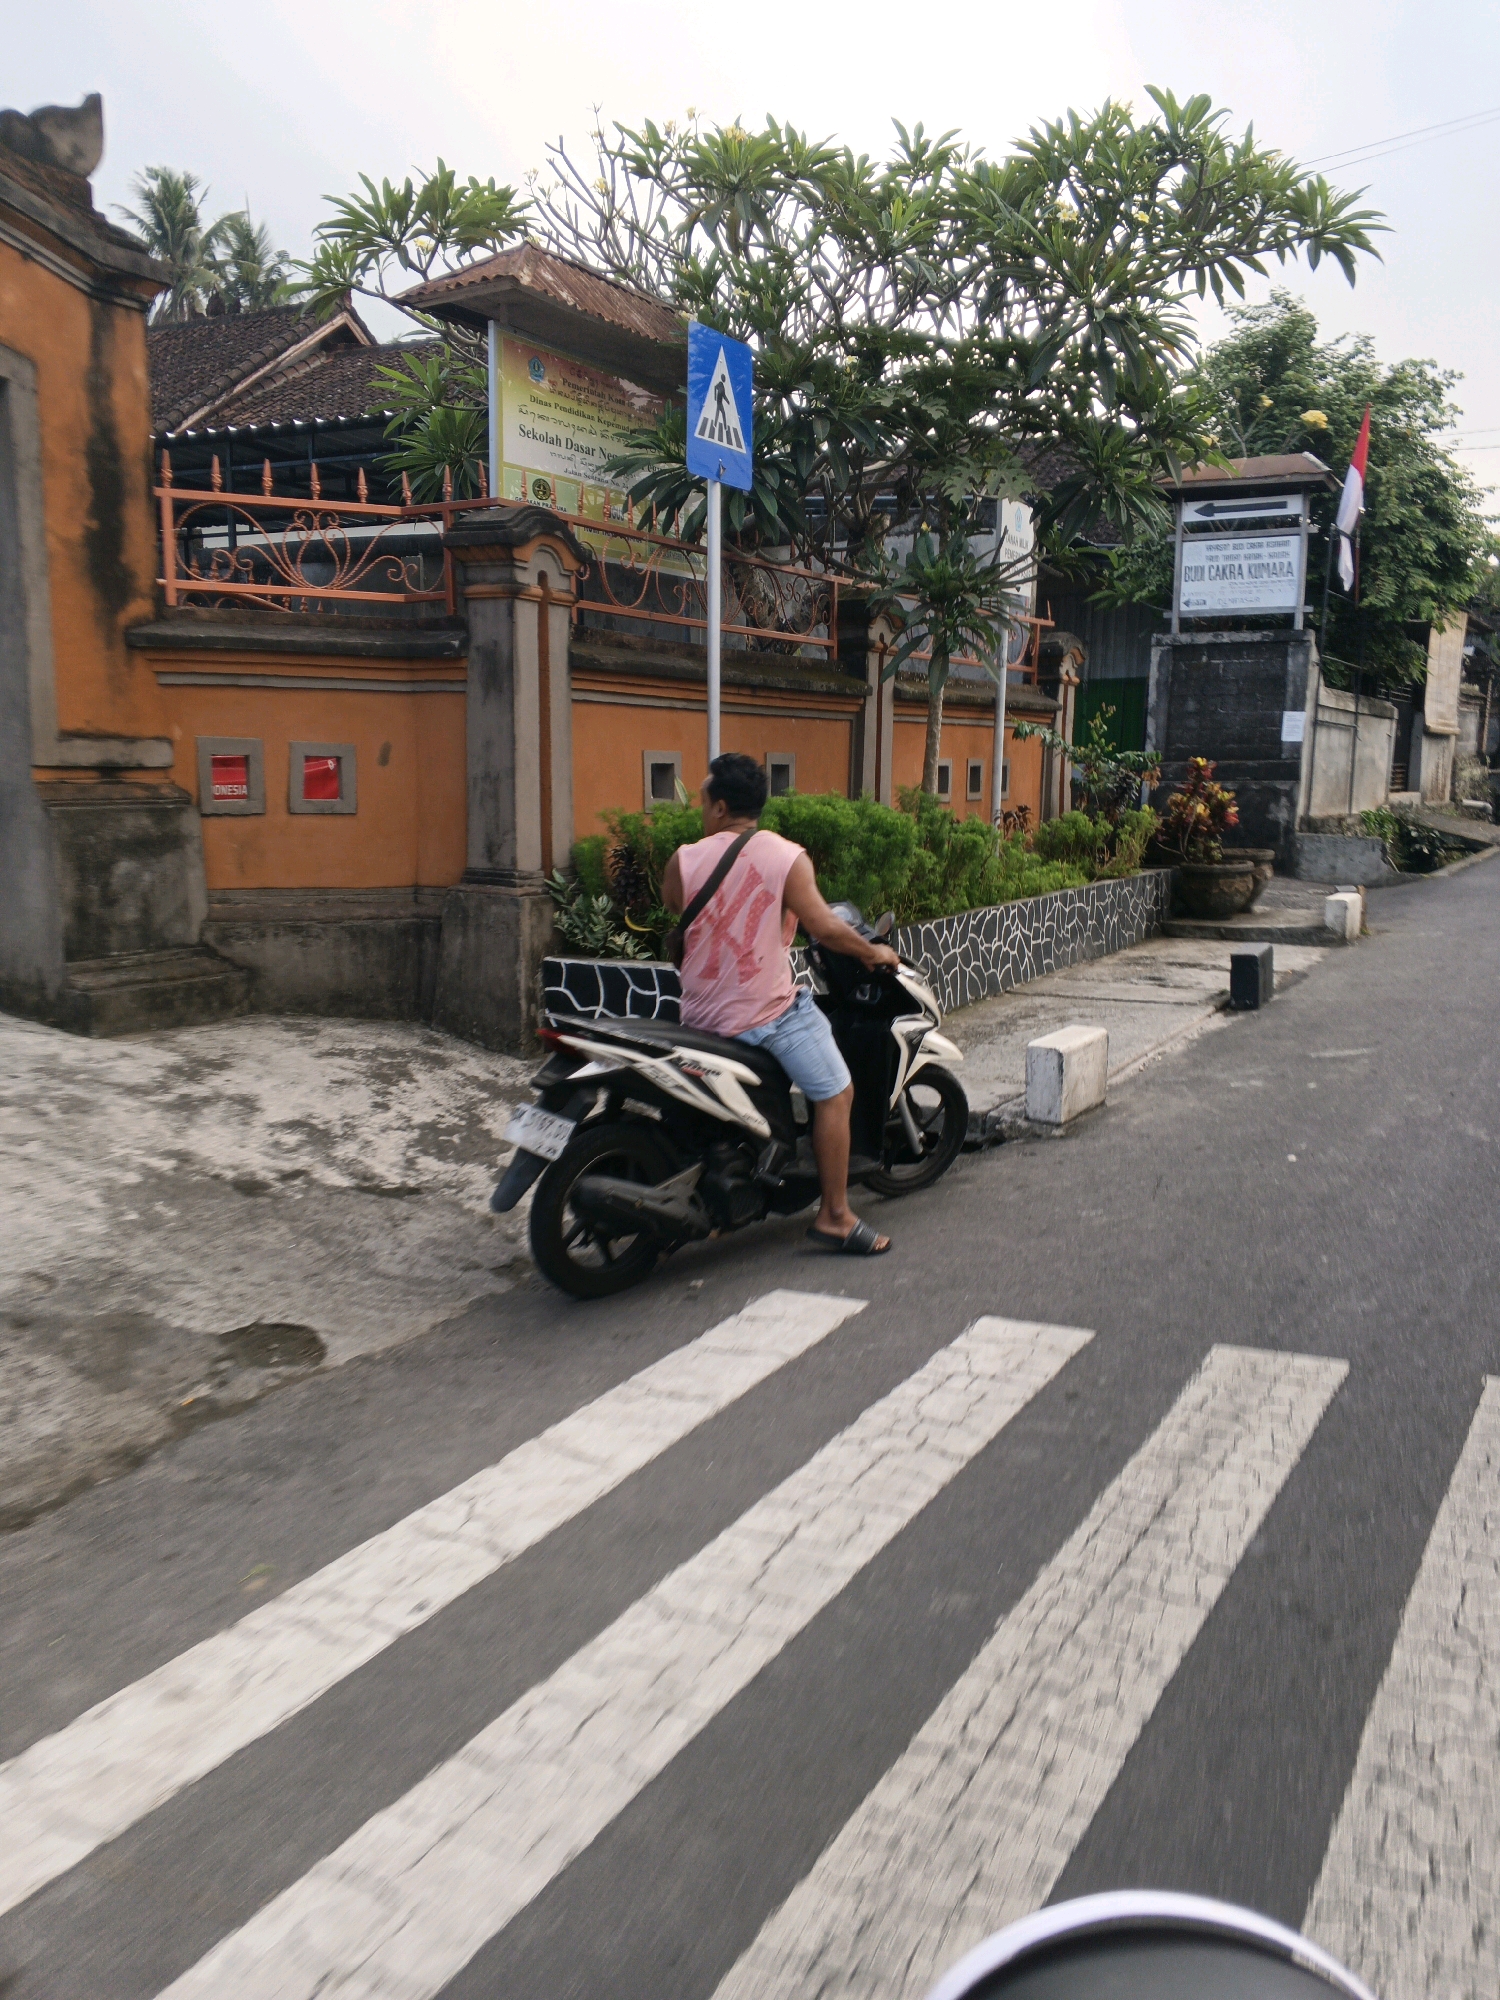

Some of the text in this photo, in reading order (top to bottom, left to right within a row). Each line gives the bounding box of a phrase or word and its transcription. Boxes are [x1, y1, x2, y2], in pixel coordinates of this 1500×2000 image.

[562, 377, 606, 400] Pemerintah
[530, 394, 552, 408] Dinas
[554, 402, 595, 421] Pendidikan
[518, 423, 562, 448] Sekolah
[565, 437, 596, 457] Dasar
[564, 468, 582, 477] Jalan
[514, 496, 567, 514] GEAKAN PRAUKA
[1184, 563, 1205, 583] BUDI
[1208, 563, 1244, 582] CAKRA
[1248, 561, 1295, 580] KUMARA
